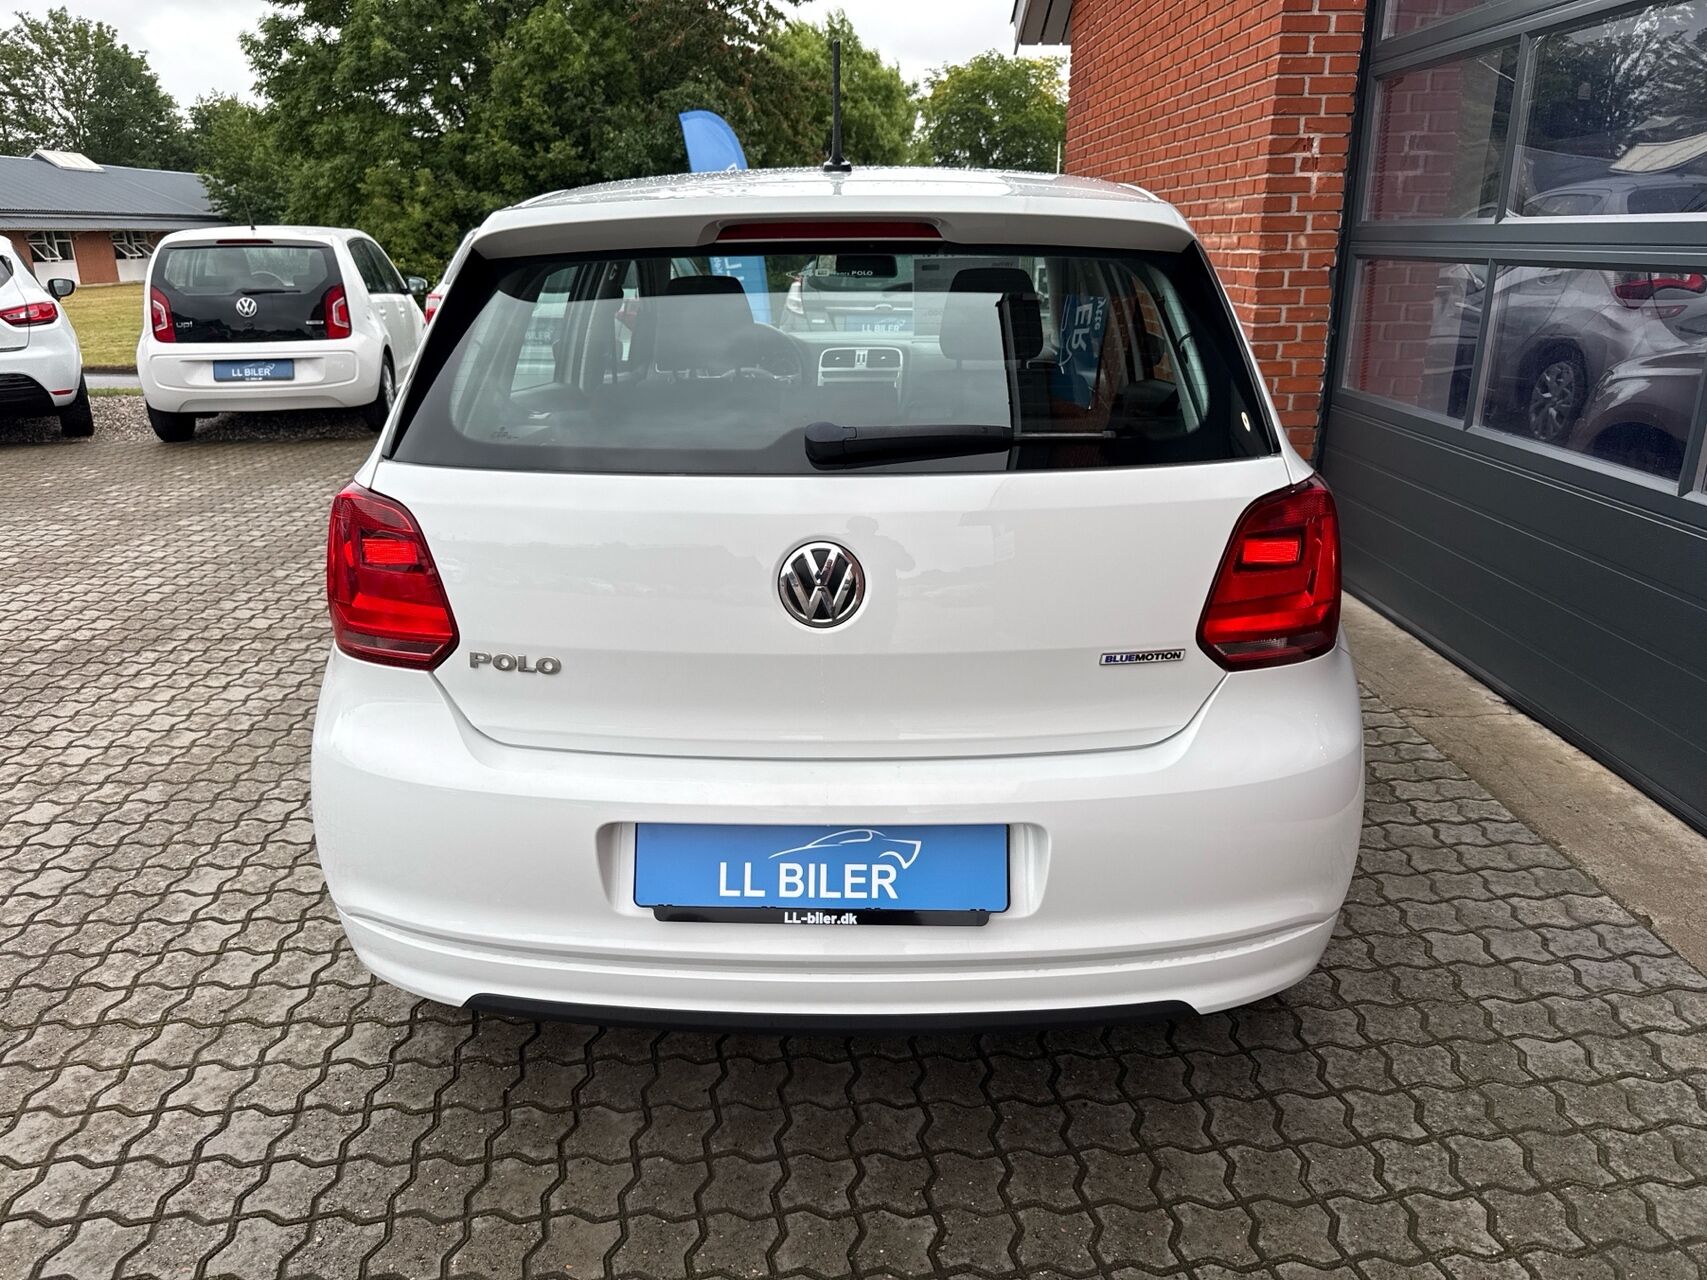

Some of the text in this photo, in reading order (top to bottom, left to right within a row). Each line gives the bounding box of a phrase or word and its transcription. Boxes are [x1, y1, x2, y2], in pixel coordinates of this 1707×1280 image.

[231, 367, 271, 377] LL BILER
[469, 651, 562, 675] POLO
[1104, 651, 1182, 663] BLUEMOTION
[719, 861, 899, 899] LL BILER
[783, 911, 858, 925] LL-biler.dk
